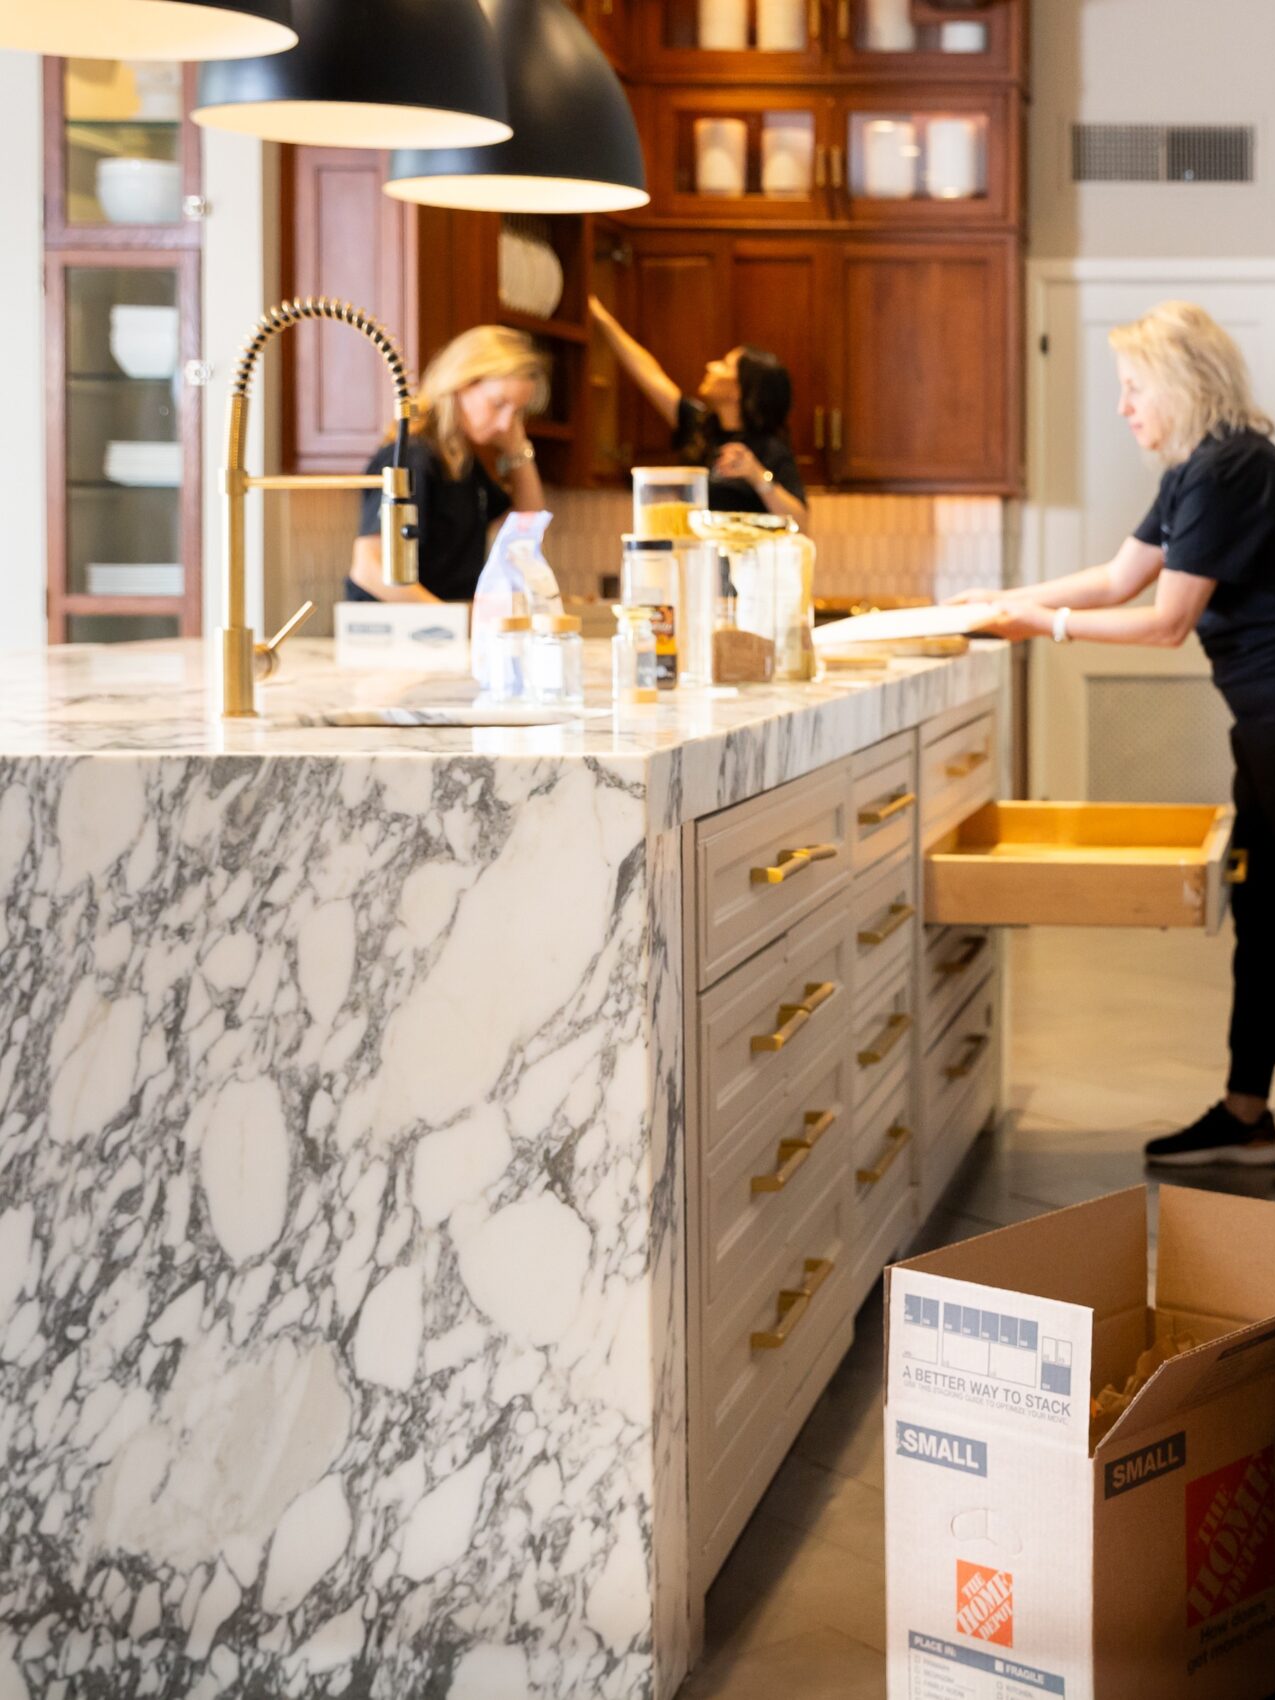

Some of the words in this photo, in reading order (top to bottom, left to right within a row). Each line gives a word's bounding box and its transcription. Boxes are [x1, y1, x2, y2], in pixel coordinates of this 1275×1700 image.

[902, 1365, 911, 1379] A
[915, 1367, 966, 1392] BETTER
[970, 1380, 1000, 1399] WAY
[1003, 1388, 1021, 1405] TO
[1025, 1393, 1071, 1417] STACK
[901, 1429, 979, 1469] SMALL
[1111, 1442, 1179, 1489] SMALL
[1188, 1453, 1274, 1617] HOME
[1195, 1483, 1232, 1546] THE
[957, 1570, 1013, 1635] HOME
[961, 1571, 986, 1599] THE
[978, 1600, 1013, 1641] DEPOT
[914, 1635, 943, 1652] PLACE
[1005, 1663, 1044, 1685] FRAGILE
